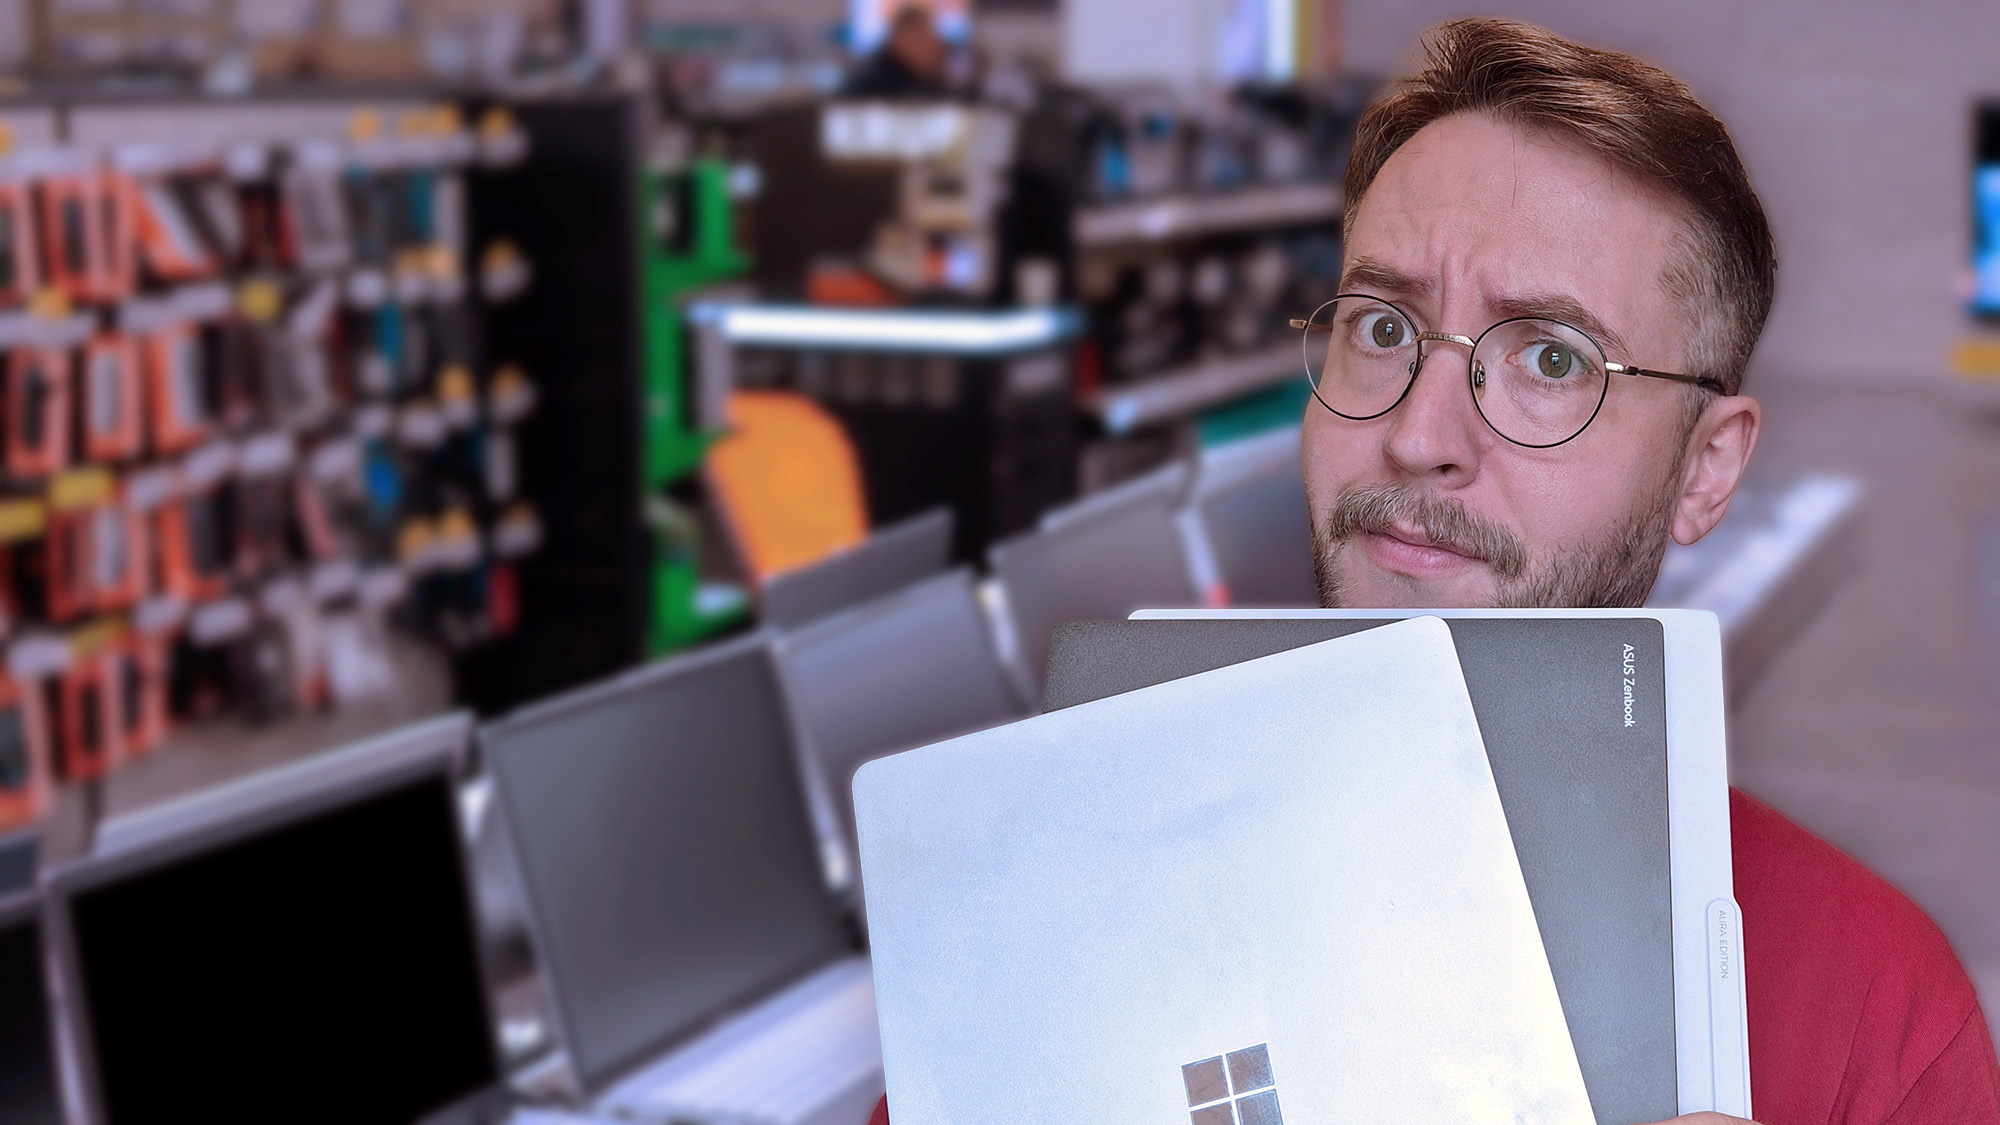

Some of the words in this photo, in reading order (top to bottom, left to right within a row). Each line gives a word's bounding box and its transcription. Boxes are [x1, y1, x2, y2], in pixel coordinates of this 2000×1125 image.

[1623, 643, 1635, 675] ASUS
[1624, 678, 1636, 728] Zenbook
[1718, 910, 1728, 937] AURA
[1719, 940, 1729, 979] EDITION
